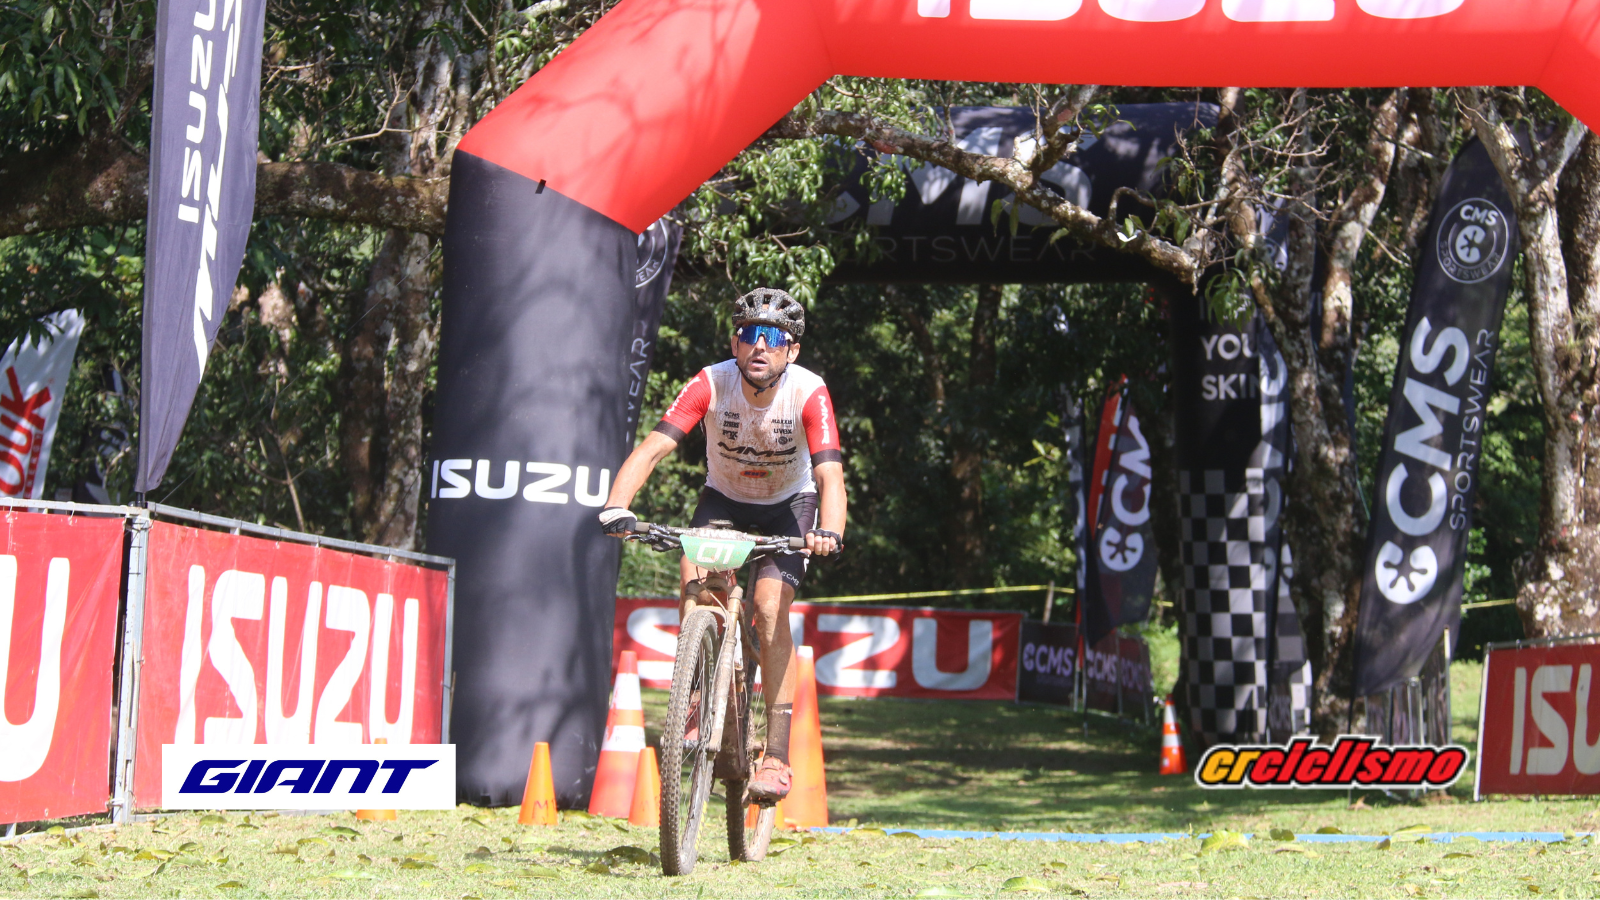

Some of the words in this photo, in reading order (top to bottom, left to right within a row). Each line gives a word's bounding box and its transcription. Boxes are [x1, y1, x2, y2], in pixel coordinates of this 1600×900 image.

[822, 125, 1098, 227] MS
[1460, 204, 1499, 226] CMS
[818, 395, 830, 445] MMR
[1386, 316, 1470, 536] CMS
[1450, 328, 1494, 531] SPORTSWEAR
[431, 458, 610, 507] ISUZU
[174, 564, 420, 745] ISUZU
